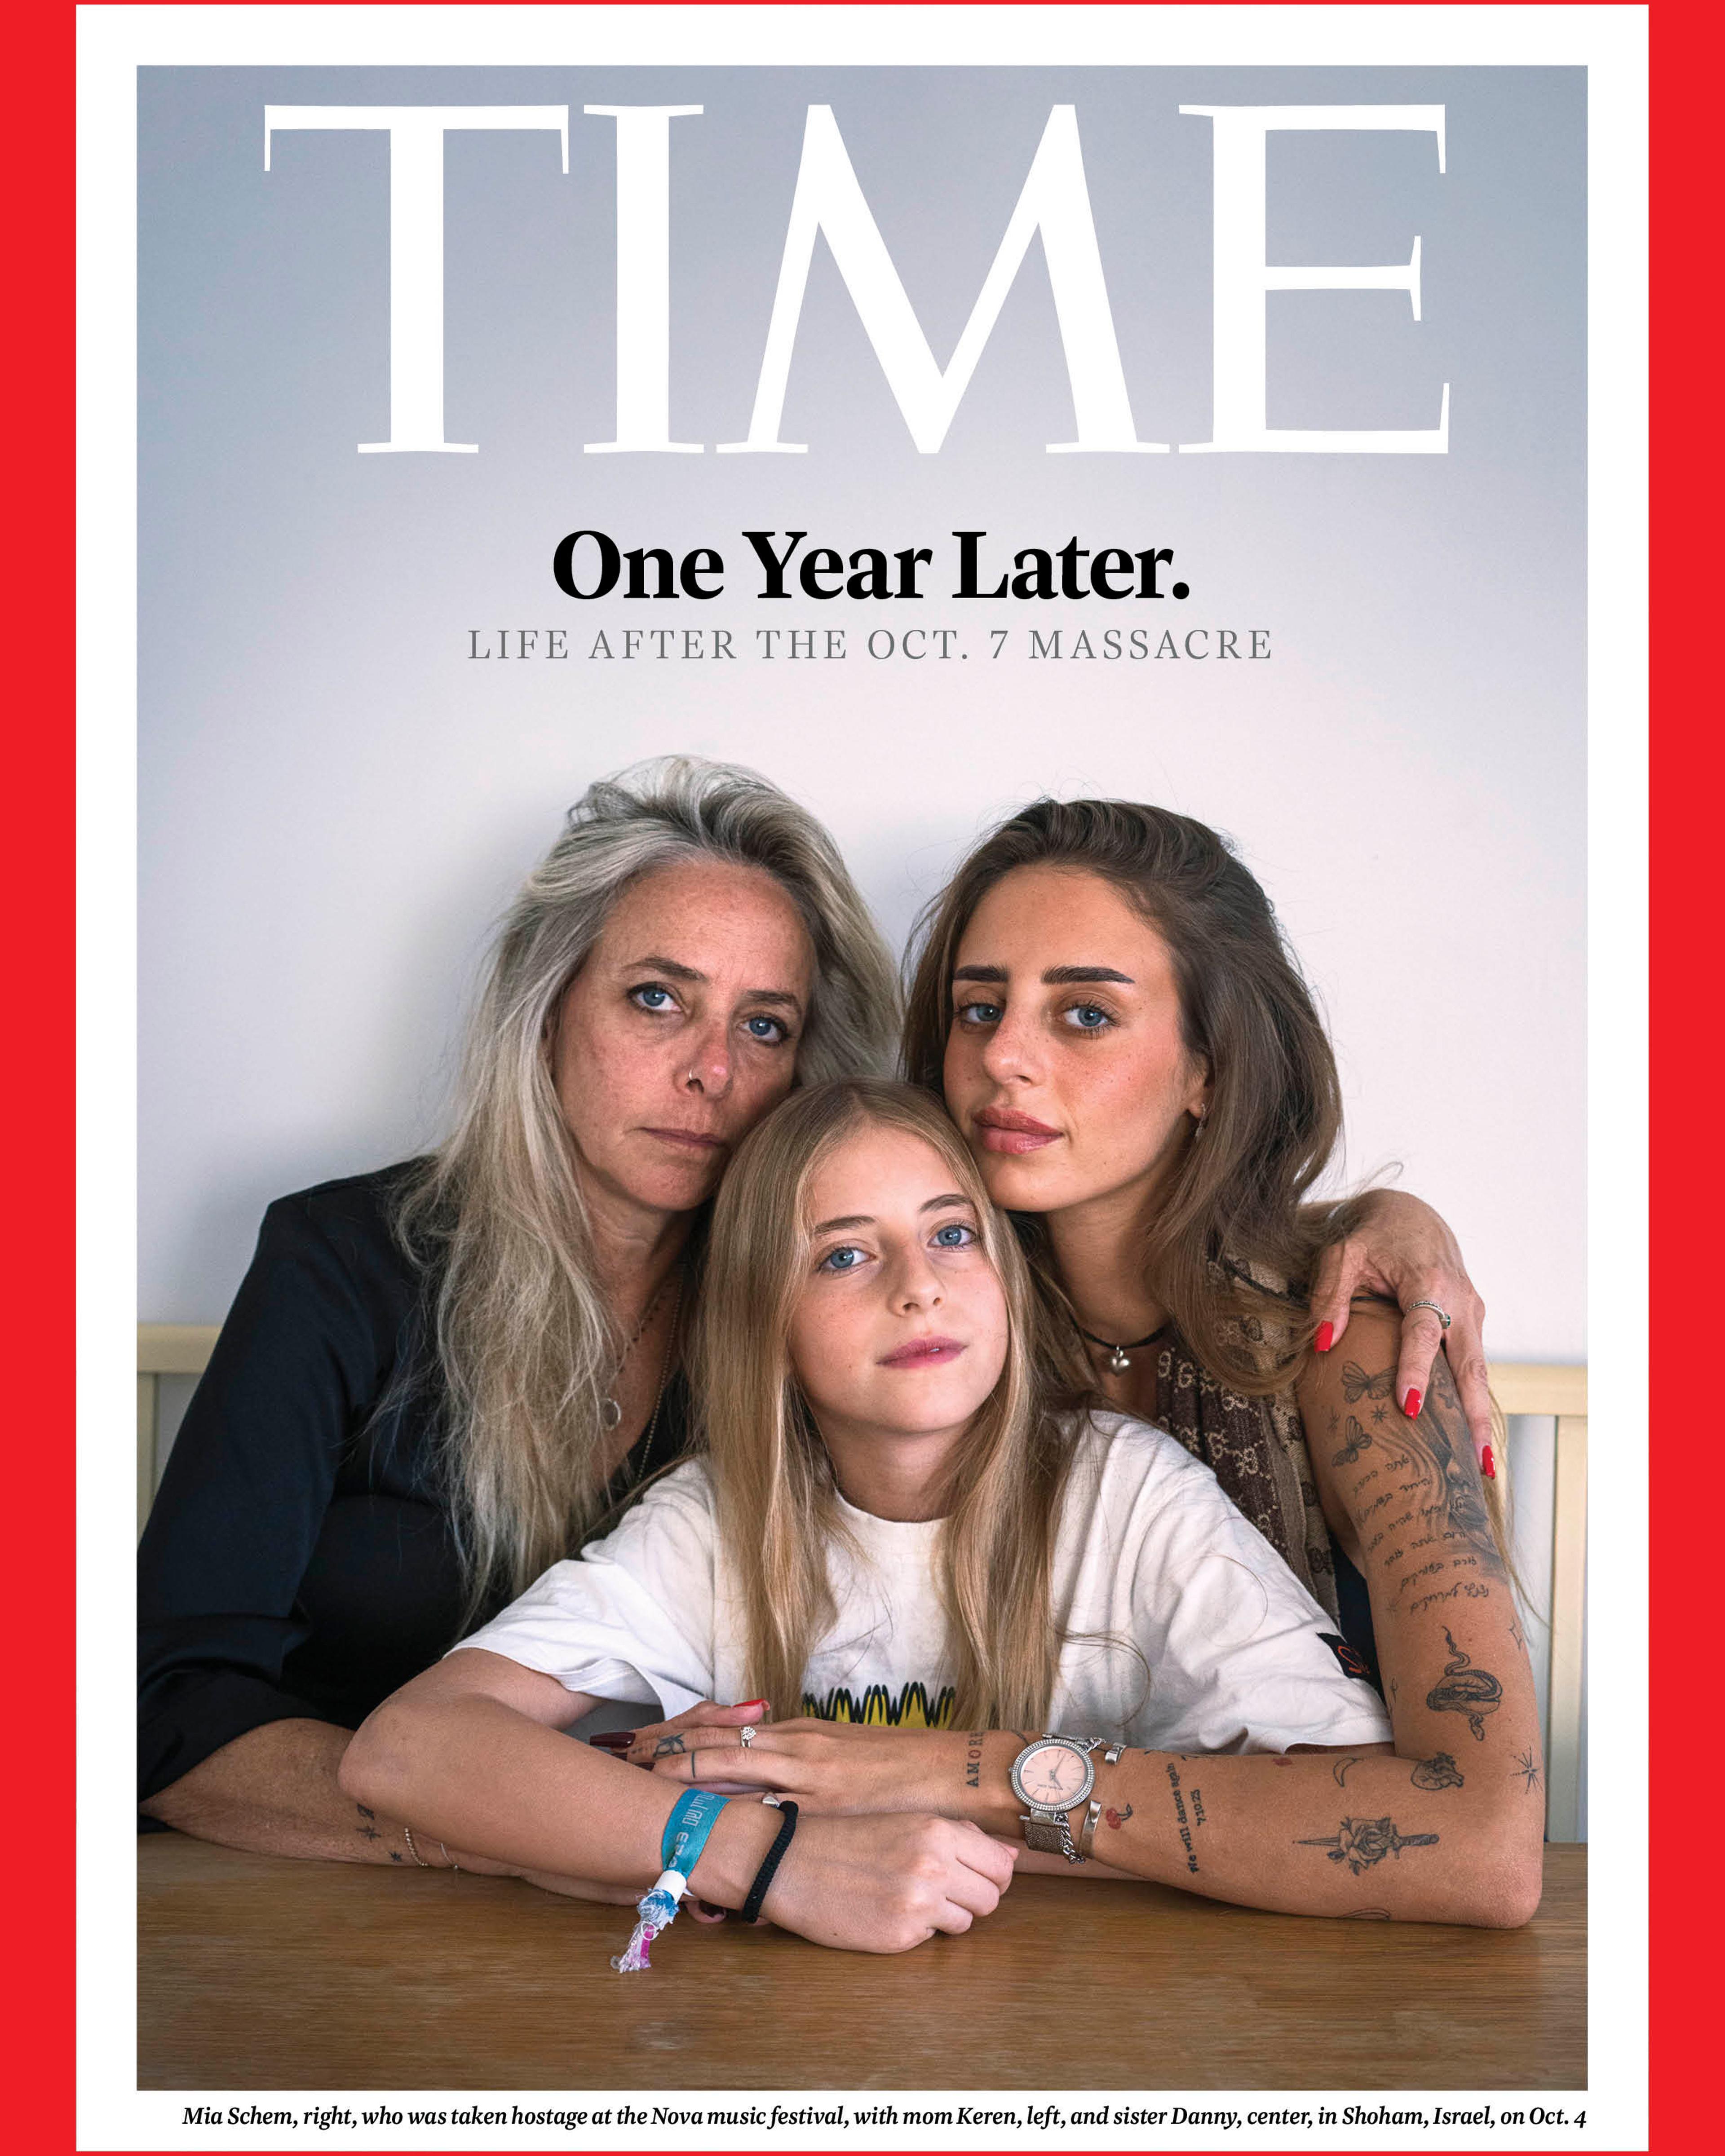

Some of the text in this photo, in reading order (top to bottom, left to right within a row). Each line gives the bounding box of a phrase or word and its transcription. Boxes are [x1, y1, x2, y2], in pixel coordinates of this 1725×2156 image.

[966, 1732, 983, 1787] AMORE
[1166, 1763, 1199, 1873] We will dance again
